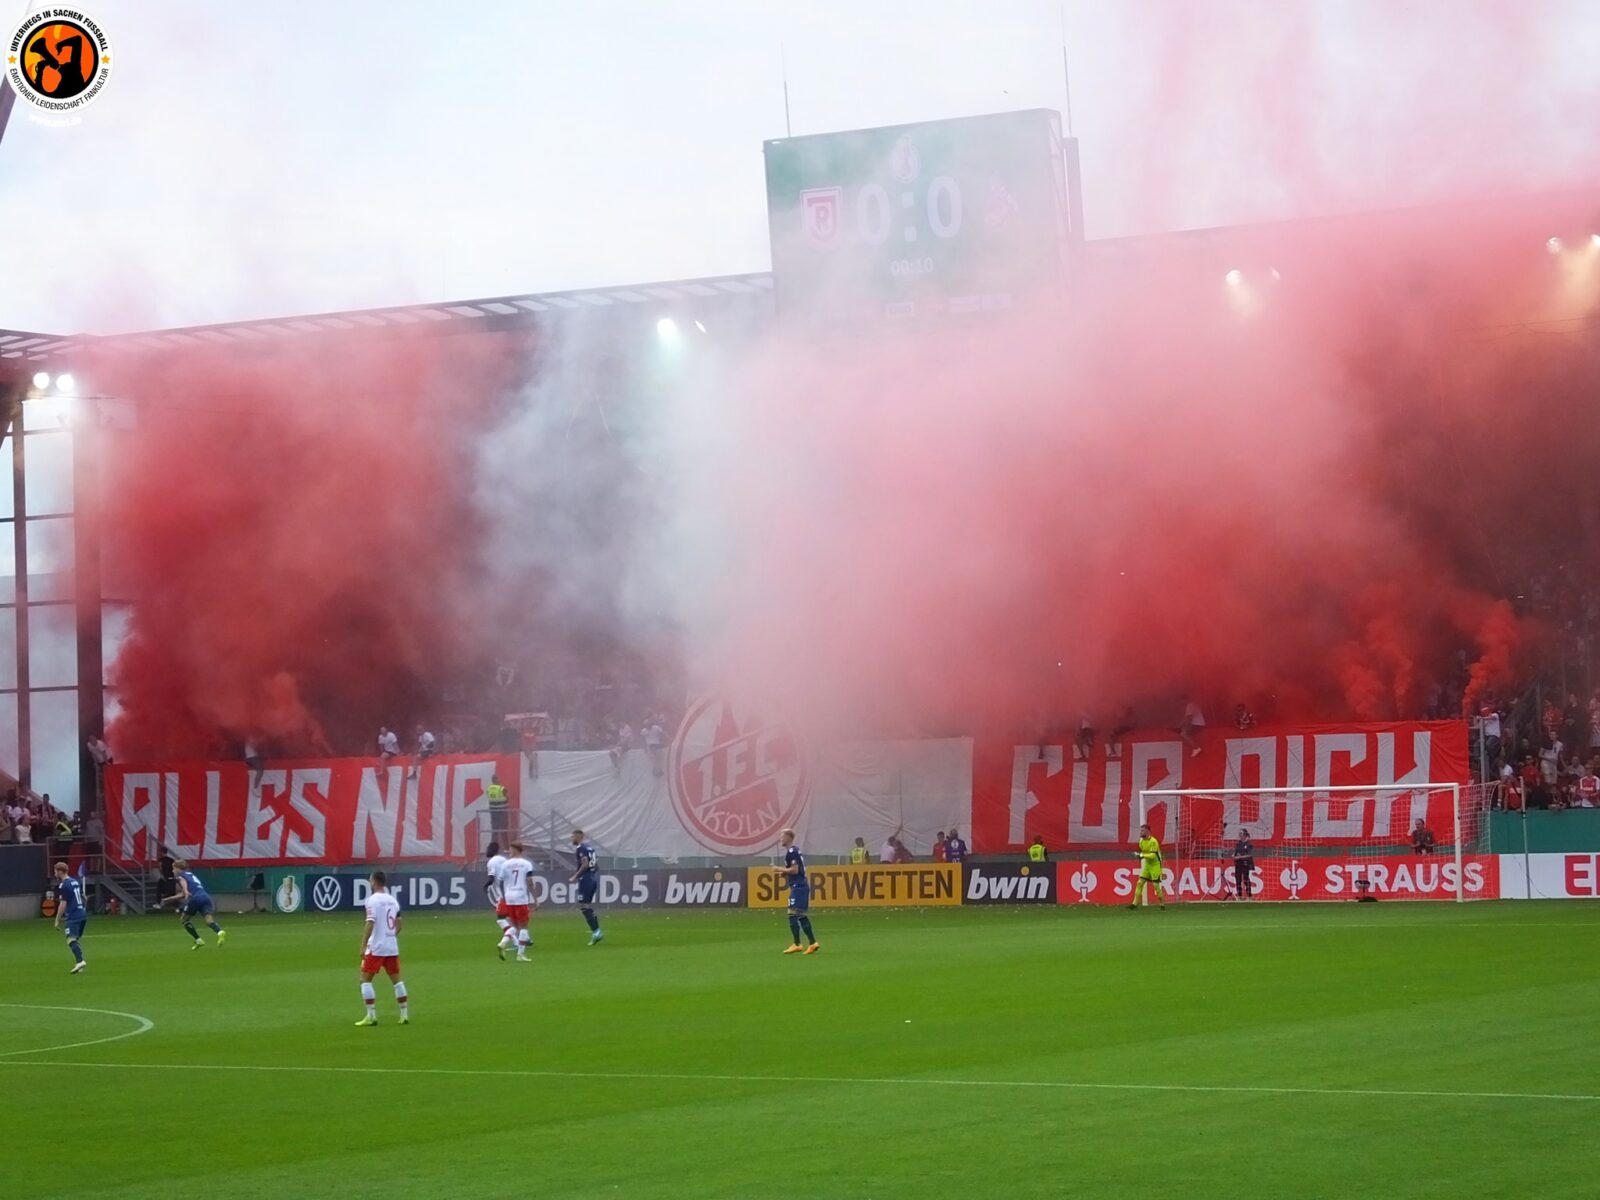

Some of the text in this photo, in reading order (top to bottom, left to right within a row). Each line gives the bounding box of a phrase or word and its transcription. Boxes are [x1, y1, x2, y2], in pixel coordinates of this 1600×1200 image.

[1008, 731, 1431, 844] FÜR DICH
[121, 761, 498, 860] ALLES NUR
[702, 801, 778, 837] KÖLN
[353, 876, 467, 907] Dr ID.5
[511, 870, 519, 887] 7
[592, 874, 649, 904] D.5
[665, 872, 740, 904] bwin
[757, 870, 953, 901] SPRTWETTEN
[967, 866, 1050, 899] bwin
[1325, 863, 1484, 893] STRAUSS
[386, 908, 396, 931] 6
